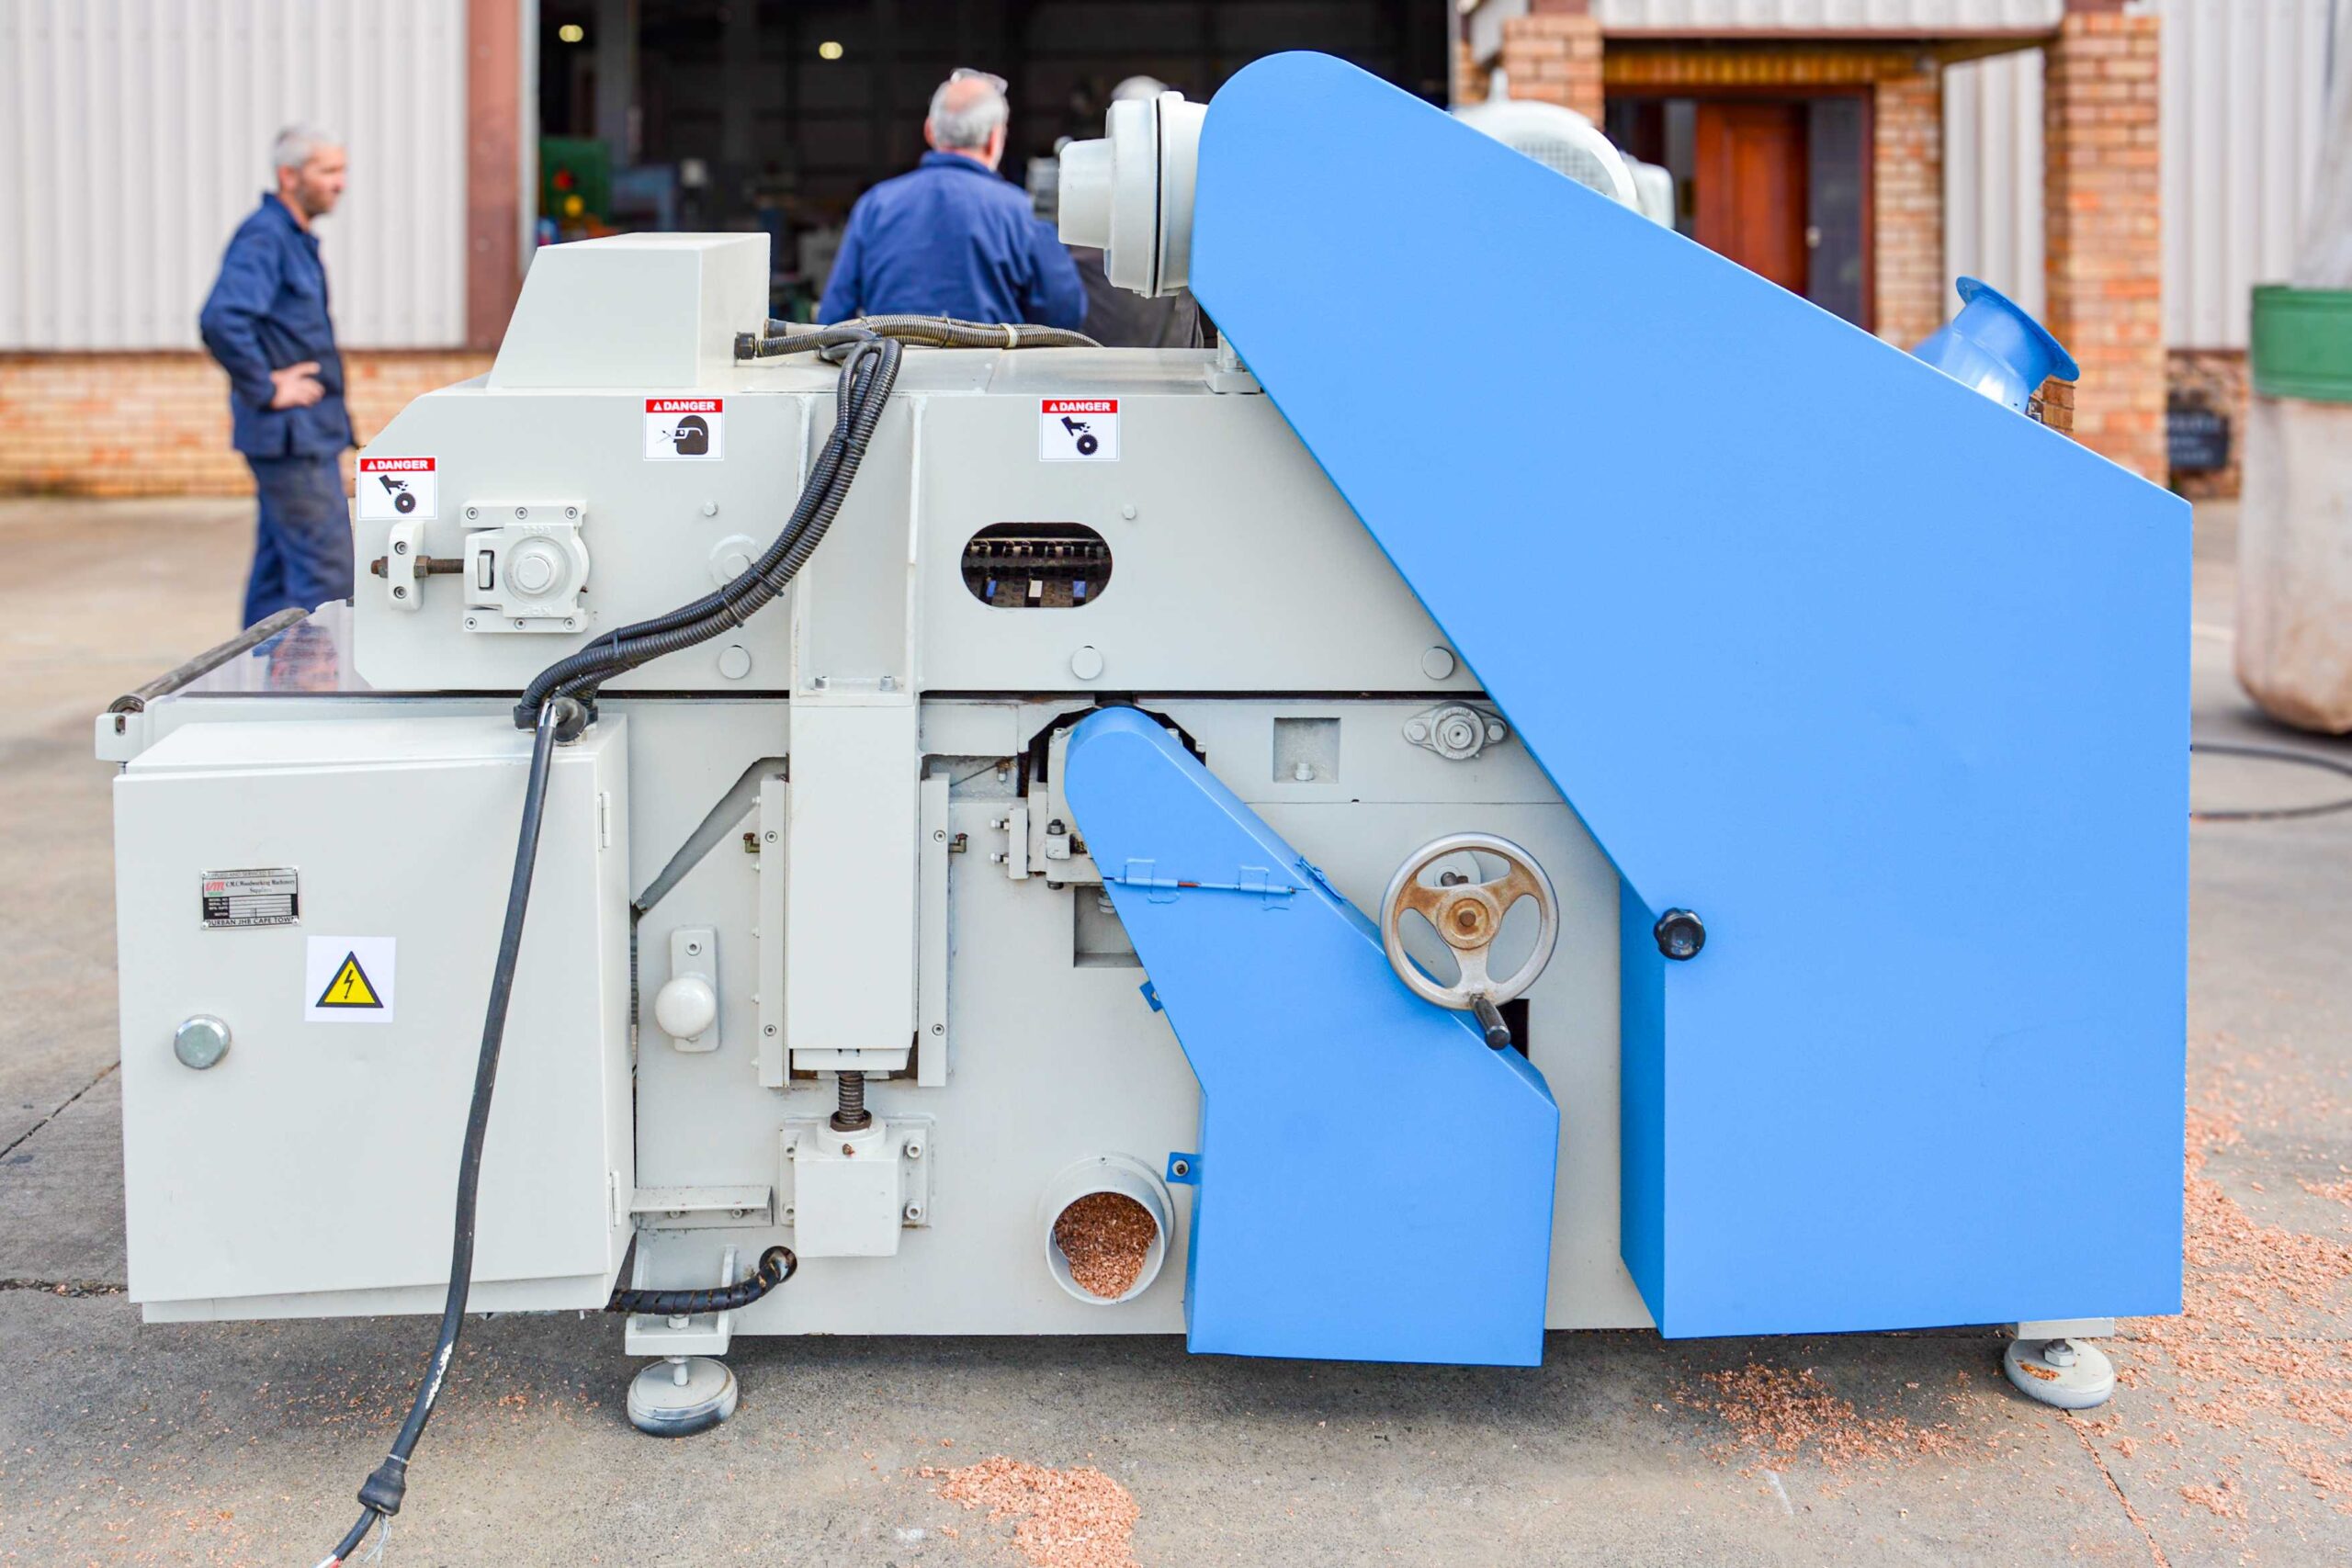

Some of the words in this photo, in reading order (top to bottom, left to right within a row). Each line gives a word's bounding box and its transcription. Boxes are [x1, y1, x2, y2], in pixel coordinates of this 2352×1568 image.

[663, 400, 716, 412] DANGER
[1058, 401, 1111, 412] DANGER
[377, 460, 428, 470] DANGER
